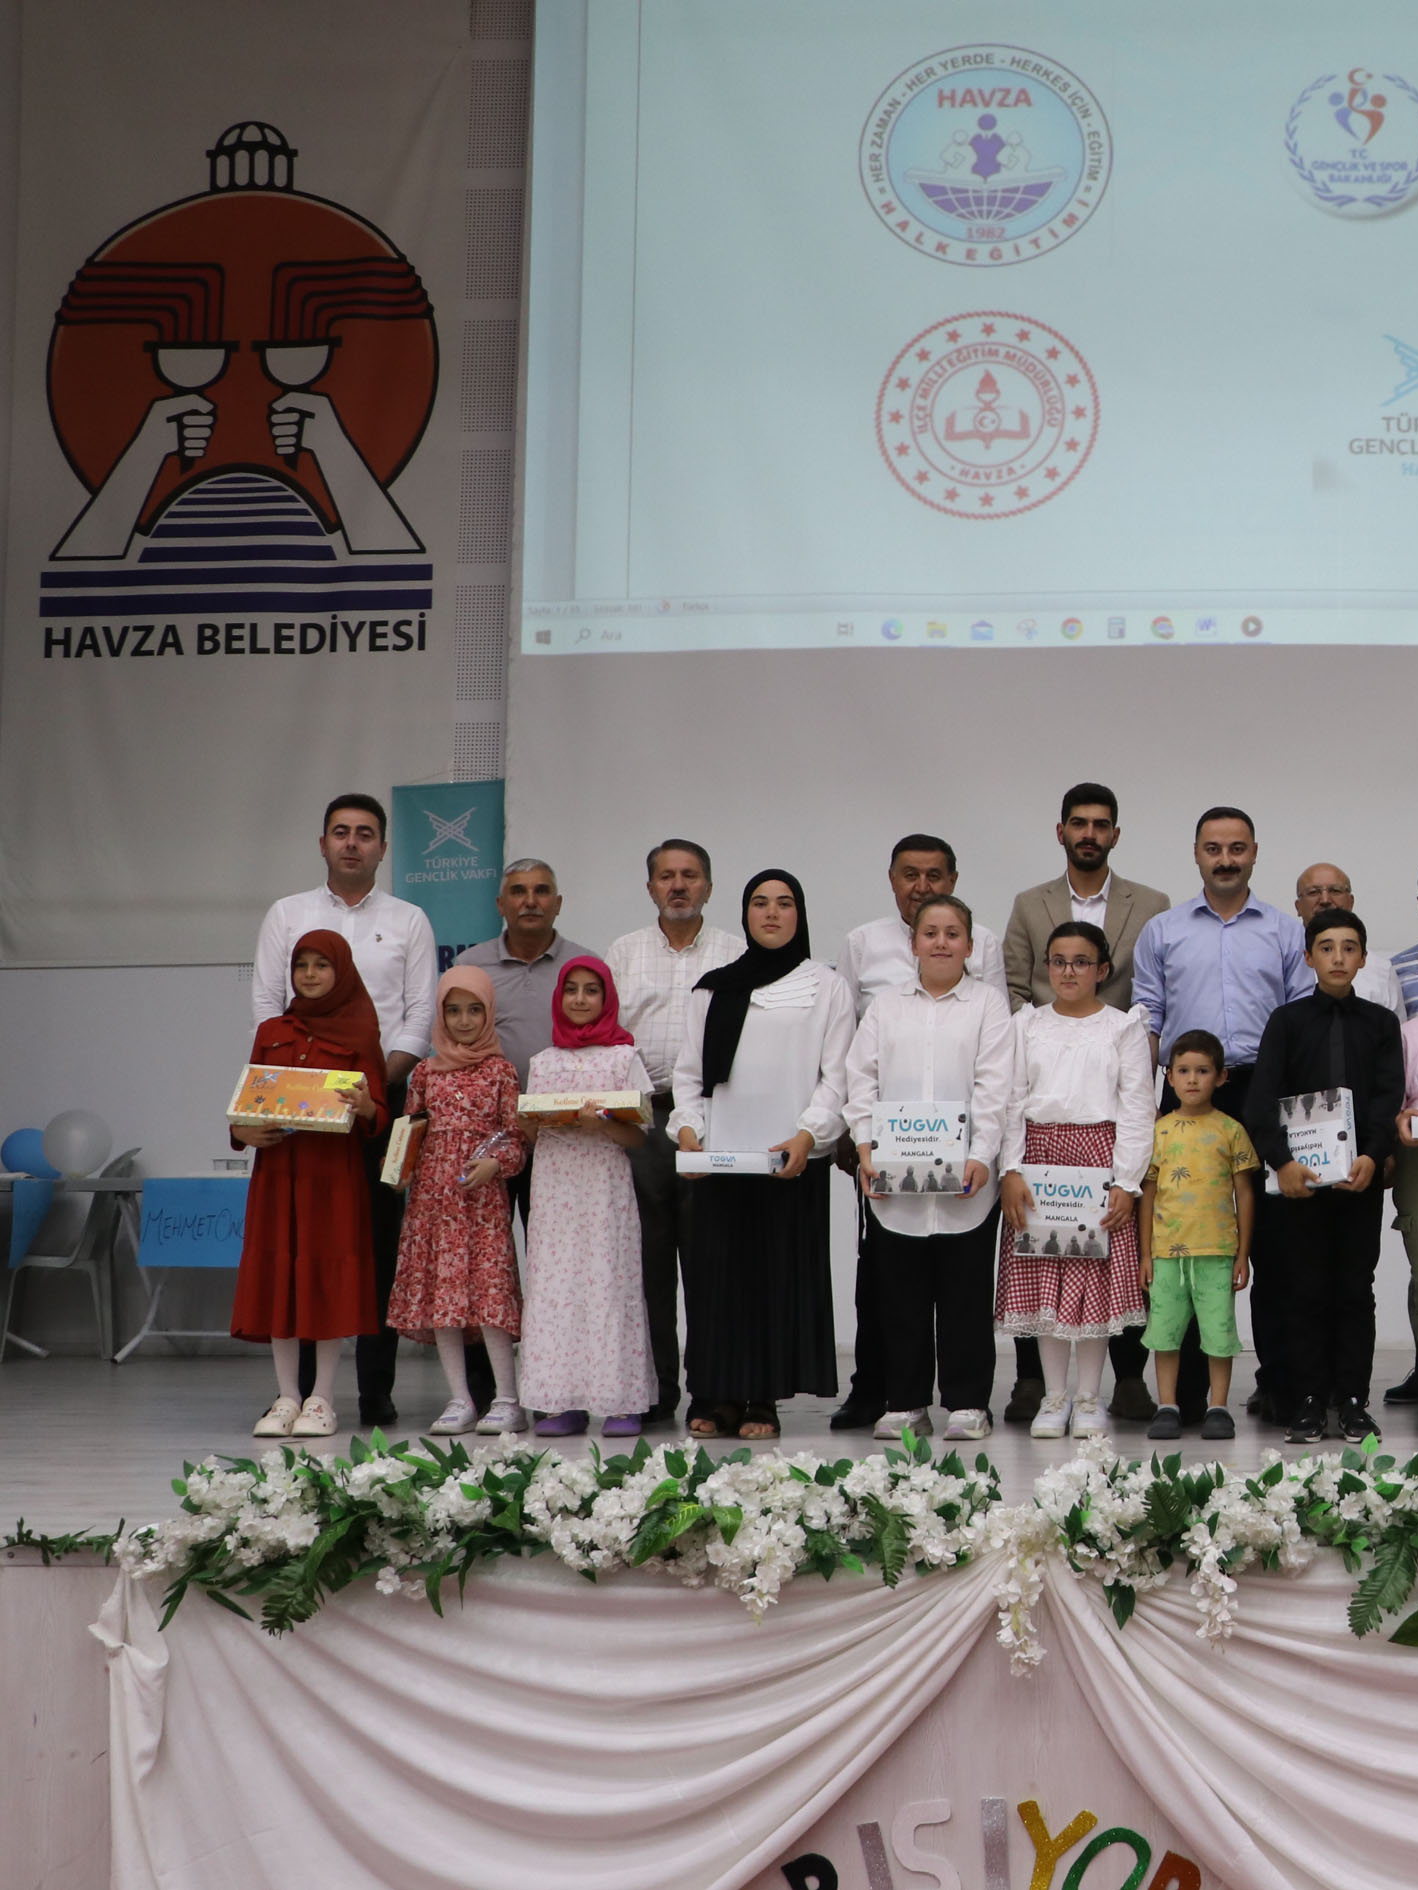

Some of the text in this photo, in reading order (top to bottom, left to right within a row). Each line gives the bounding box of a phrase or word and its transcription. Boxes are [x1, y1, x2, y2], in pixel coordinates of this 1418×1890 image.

[904, 65, 938, 93] HER
[938, 53, 995, 72] YERDE
[1009, 55, 1071, 93] HERKES
[937, 87, 1033, 108] HAVZA
[870, 97, 902, 149] ZAMAN
[869, 152, 884, 183] HER
[44, 611, 427, 659] HAVZA BELEDİYESİ
[141, 1208, 216, 1246] MEHMET
